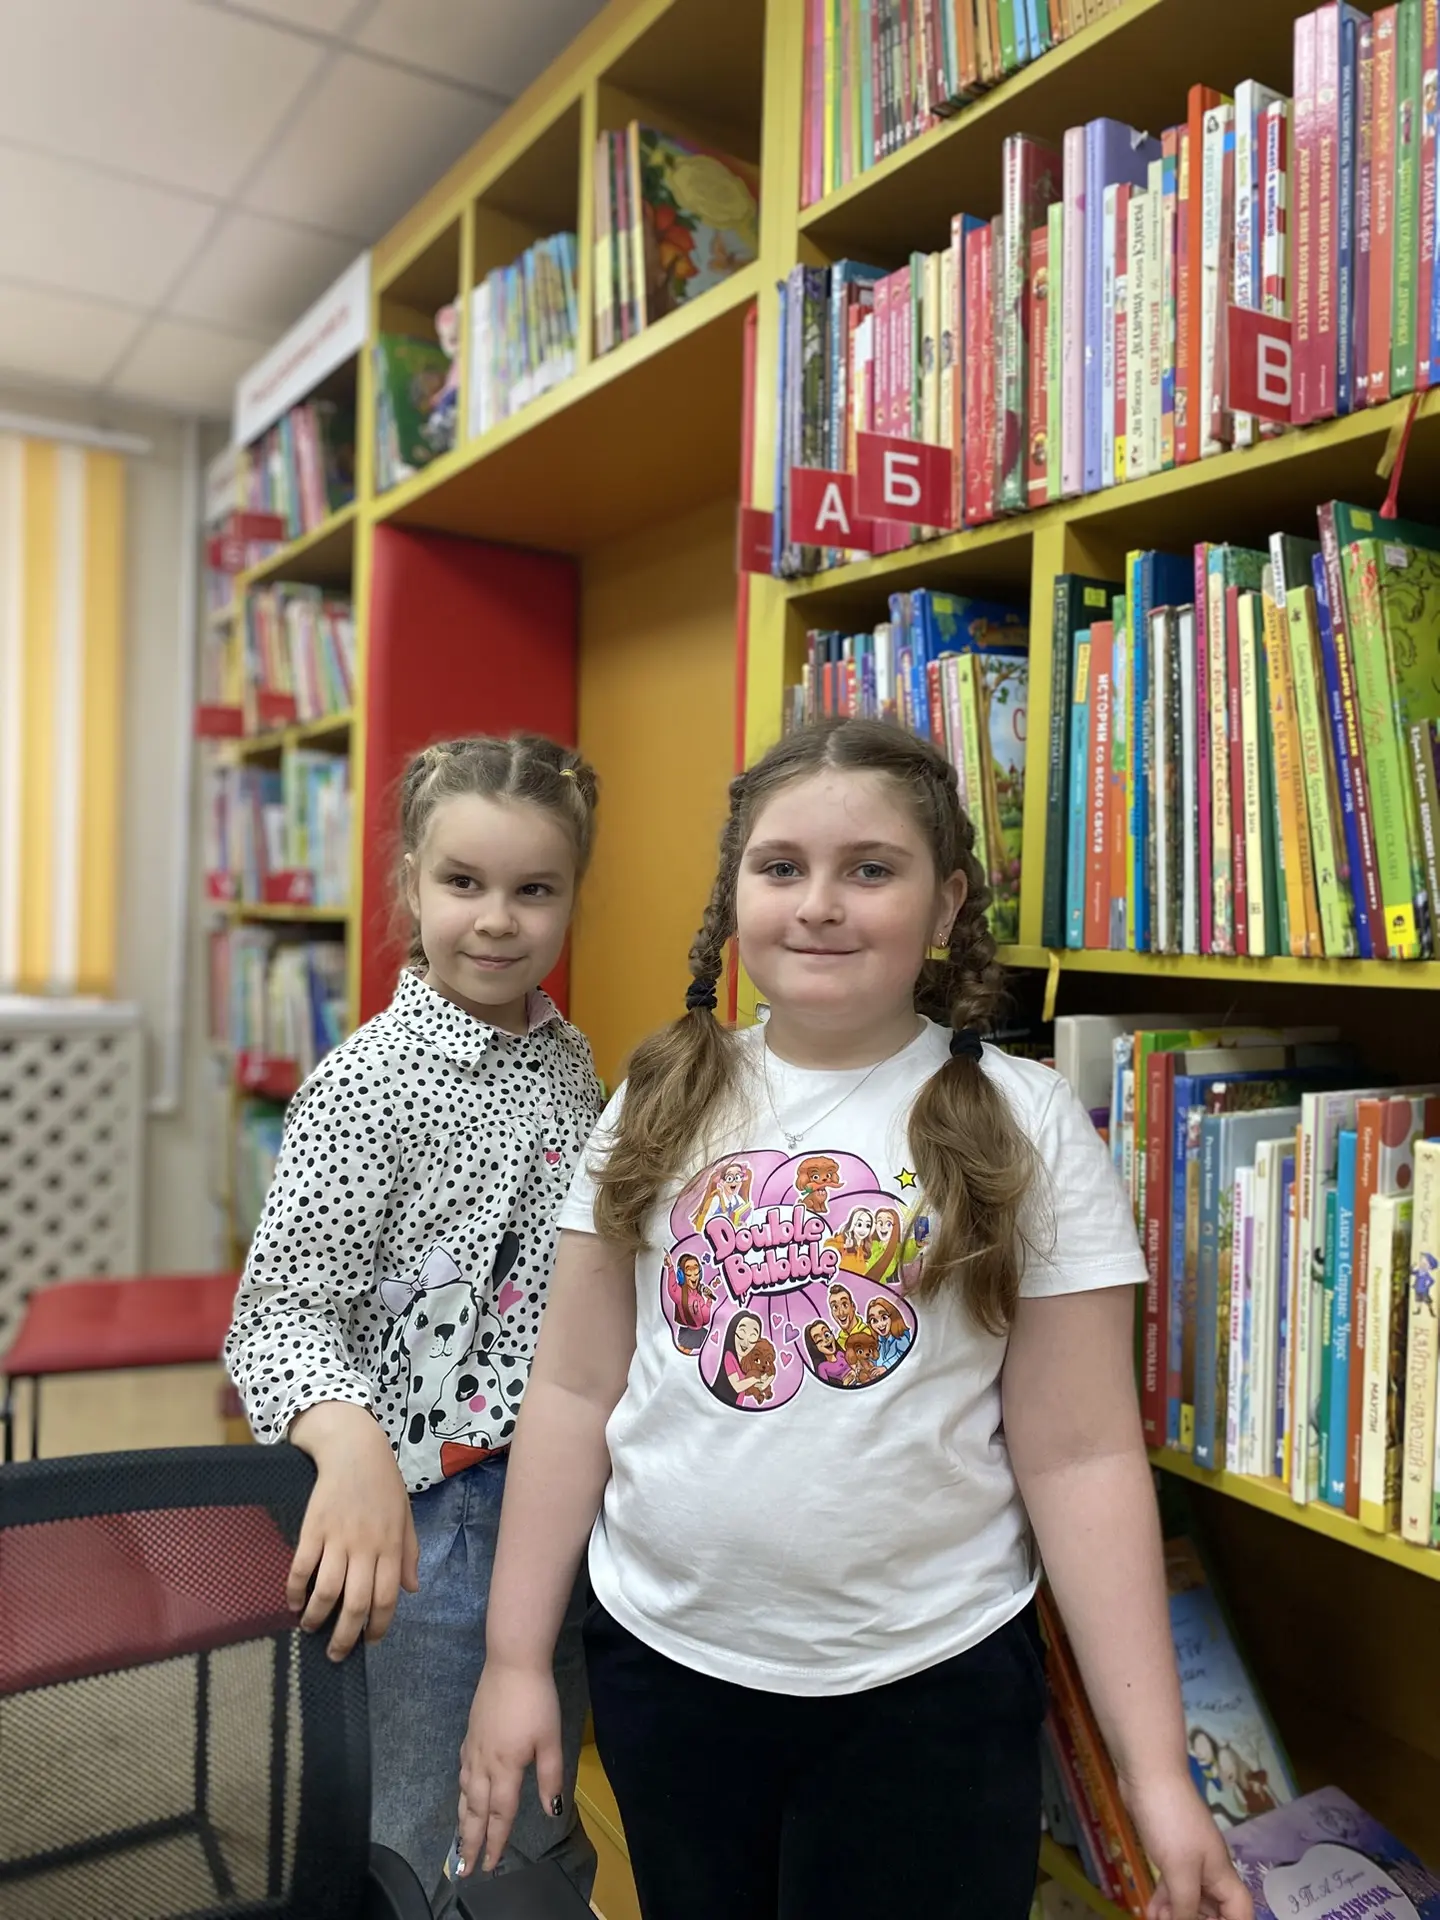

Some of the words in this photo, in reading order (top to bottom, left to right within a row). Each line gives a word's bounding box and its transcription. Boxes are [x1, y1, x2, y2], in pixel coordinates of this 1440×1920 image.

[1297, 147, 1311, 209] ЖИРАФИК
[1318, 135, 1332, 199] ЖИРАФИК
[1298, 210, 1311, 244] ВИВИ
[1318, 200, 1331, 234] ВИВИ
[1297, 245, 1310, 342] ВОЗВРАЩАЕТСЯ
[1317, 235, 1331, 334] ВОЗВРАЩАЕТСЯ
[1256, 334, 1292, 406] В
[884, 450, 921, 507] Б
[814, 482, 850, 534] А
[1096, 673, 1109, 742] ИСТОРИИ
[1269, 643, 1280, 680] Гримм
[1277, 720, 1290, 781] СКАЗКИ
[1304, 728, 1320, 776] СКАЗКИ
[1384, 832, 1400, 881] СКАЗКИ
[704, 1205, 825, 1262] Double
[1339, 1207, 1353, 1248] Алиса
[722, 1243, 838, 1306] Bubble
[1336, 1262, 1352, 1317] Стране
[1334, 1321, 1350, 1361] Чудес
[1371, 1316, 1382, 1376] КИПЛИНГ
[1370, 1382, 1380, 1433] МАУГЛИ
[1409, 1326, 1432, 1468] КАЙТУСЬ-ЧАРОДЕЙ
